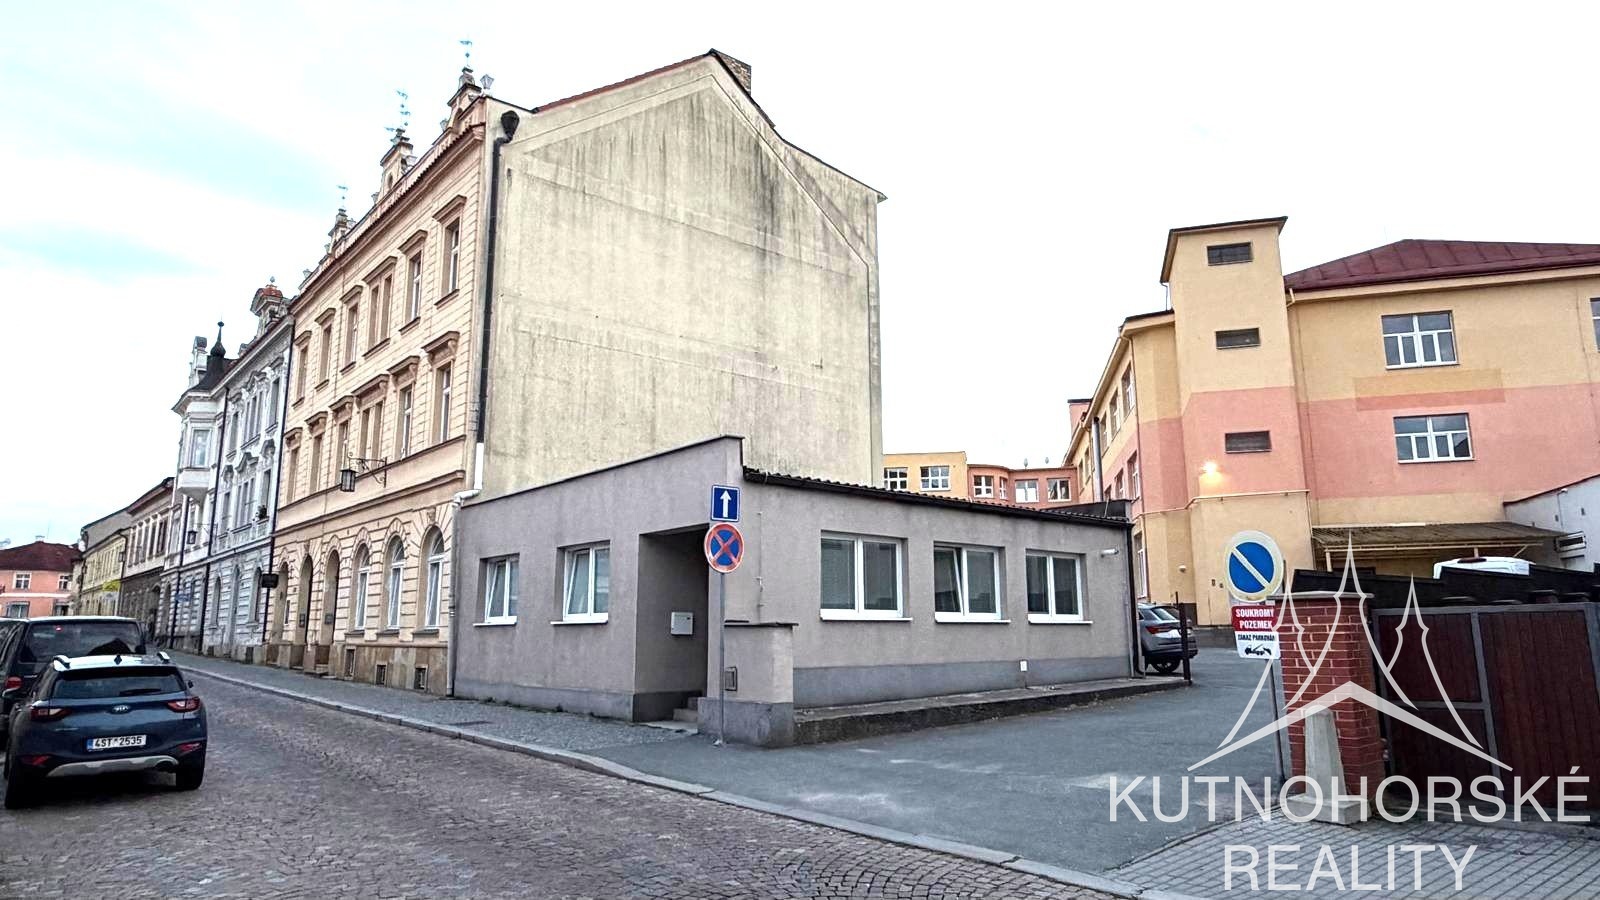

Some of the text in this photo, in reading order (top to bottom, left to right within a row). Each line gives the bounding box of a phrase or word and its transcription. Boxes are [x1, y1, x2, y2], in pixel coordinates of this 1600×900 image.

[1239, 620, 1273, 629] POZEMEK
[95, 735, 143, 748] 4ST 2535
